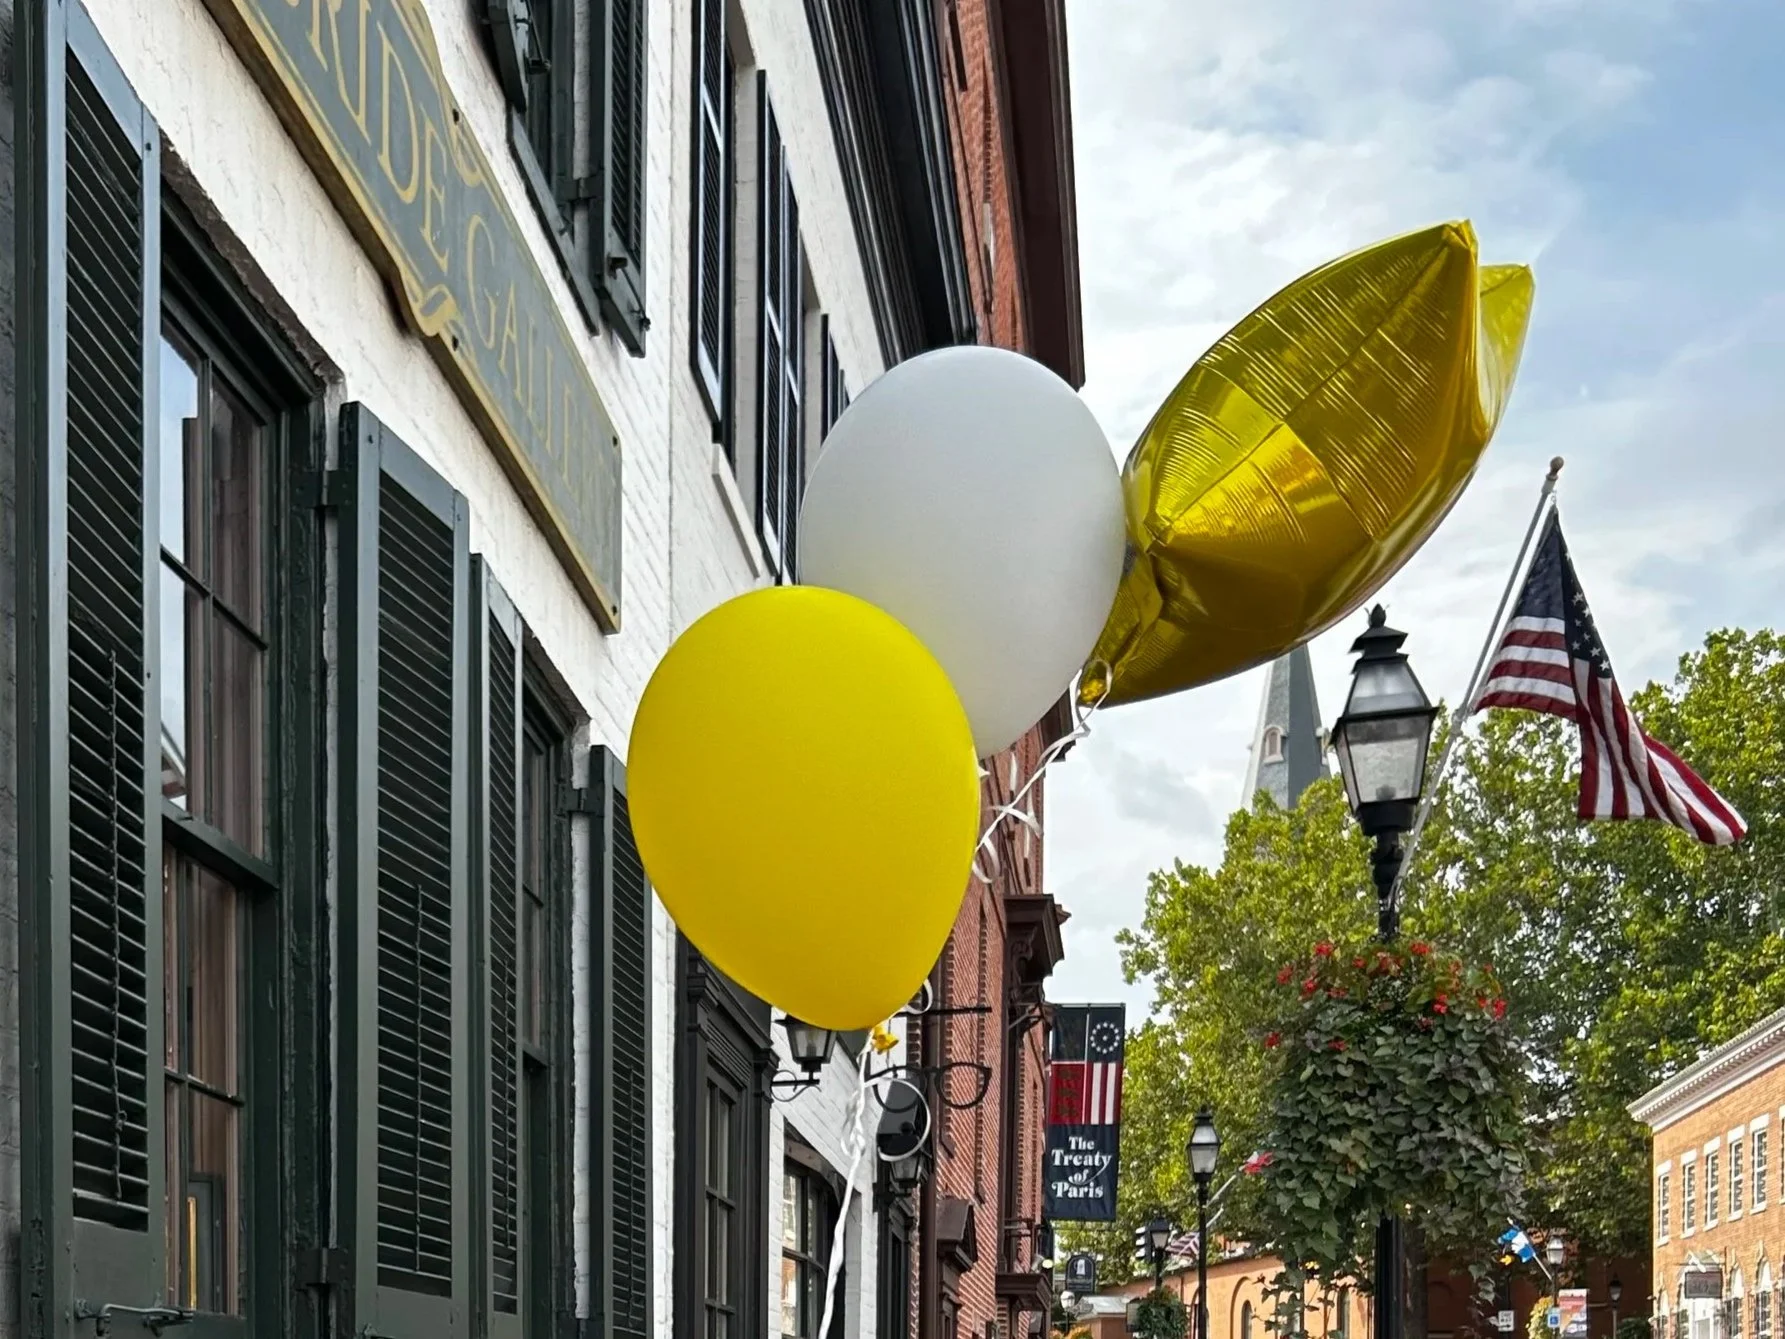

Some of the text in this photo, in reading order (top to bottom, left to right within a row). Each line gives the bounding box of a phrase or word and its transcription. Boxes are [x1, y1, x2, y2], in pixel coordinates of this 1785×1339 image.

[1068, 1136, 1095, 1150] The
[1051, 1149, 1112, 1174] Treaty
[1071, 1169, 1089, 1184] of
[1051, 1181, 1104, 1198] Paris
